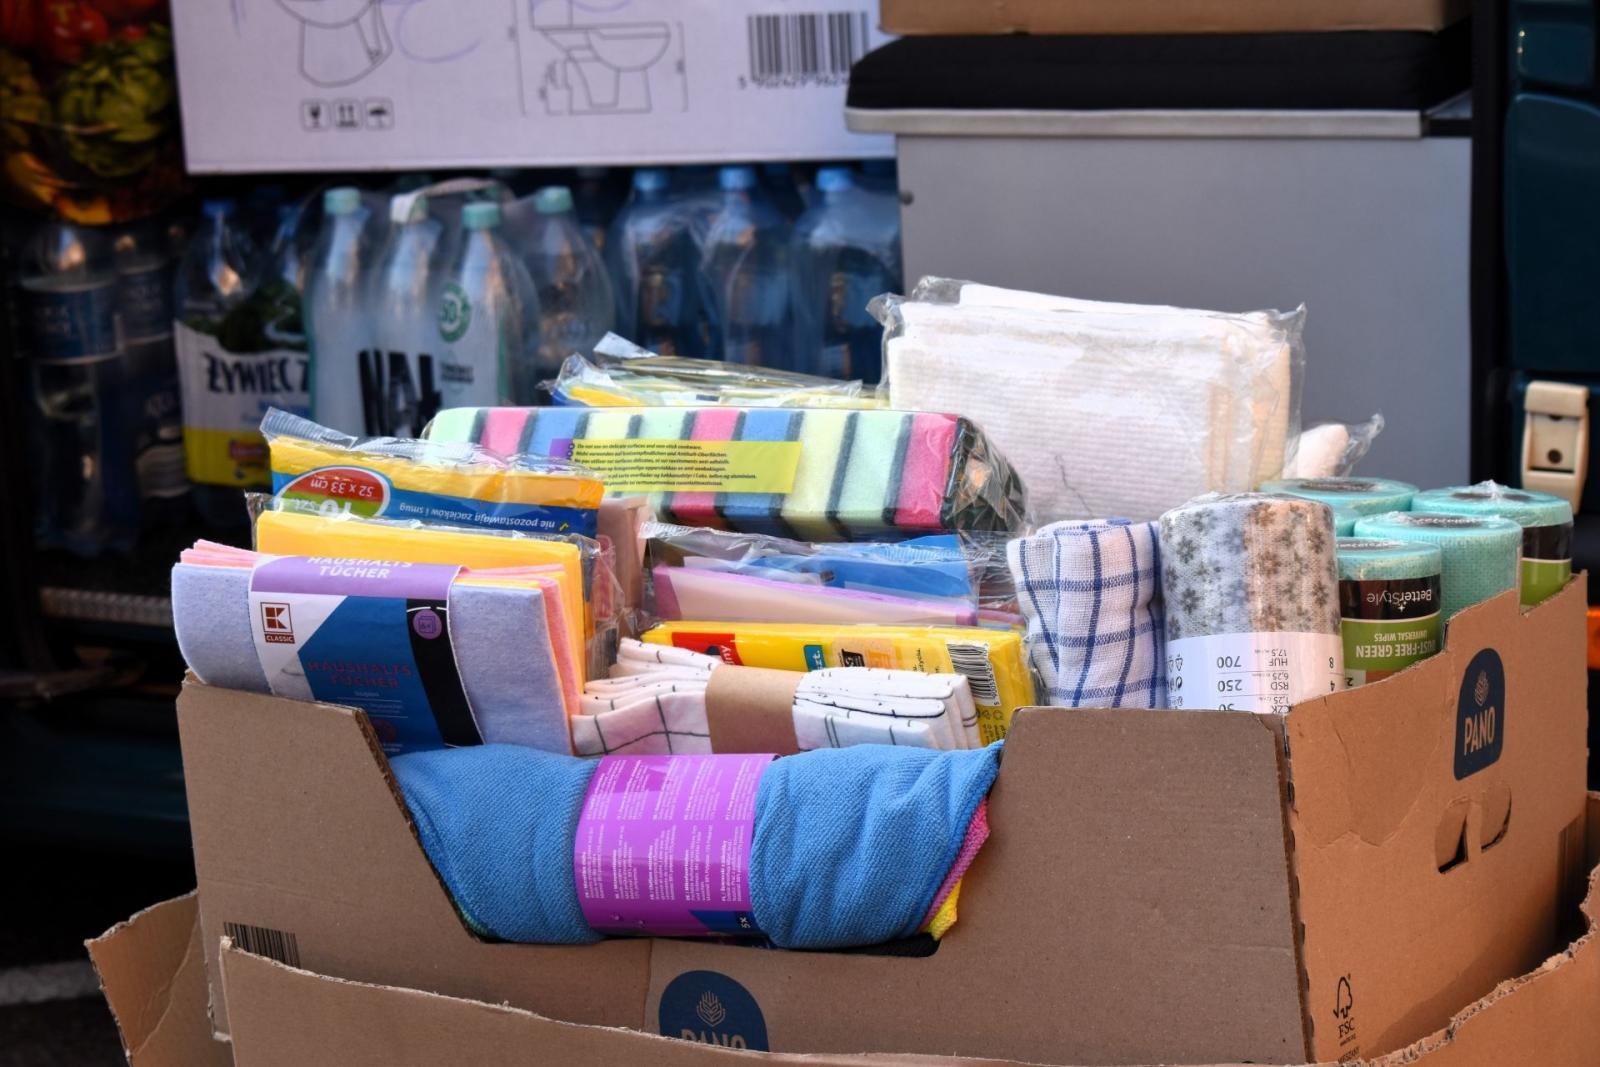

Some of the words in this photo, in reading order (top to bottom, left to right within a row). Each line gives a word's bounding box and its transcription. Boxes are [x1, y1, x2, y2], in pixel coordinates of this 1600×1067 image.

[310, 478, 329, 490] cm
[330, 481, 347, 494] 33
[349, 483, 357, 493] x
[359, 485, 375, 497] 52
[400, 502, 426, 514] smug
[431, 505, 472, 522] zacieków
[474, 511, 539, 527] pozostawiają
[540, 519, 555, 529] nie
[318, 565, 391, 579] TÜCHER
[1366, 588, 1432, 606] BetterStyle
[266, 635, 295, 644] CLASSIC
[1373, 632, 1397, 642] WIPES
[1397, 629, 1428, 641] UNIVERSAL
[1273, 649, 1287, 657] 17,5
[1355, 645, 1393, 658] GREEN
[1216, 655, 1242, 669] 700
[1268, 657, 1288, 667] HUF
[1328, 656, 1335, 669] 8
[307, 661, 413, 676] HAUSHALTS
[1272, 673, 1289, 681] 6,25
[1217, 679, 1242, 692] 250
[1270, 681, 1289, 690] RSD
[1330, 680, 1336, 692] 4
[1464, 706, 1495, 756] PANO
[1338, 1017, 1355, 1039] FSC
